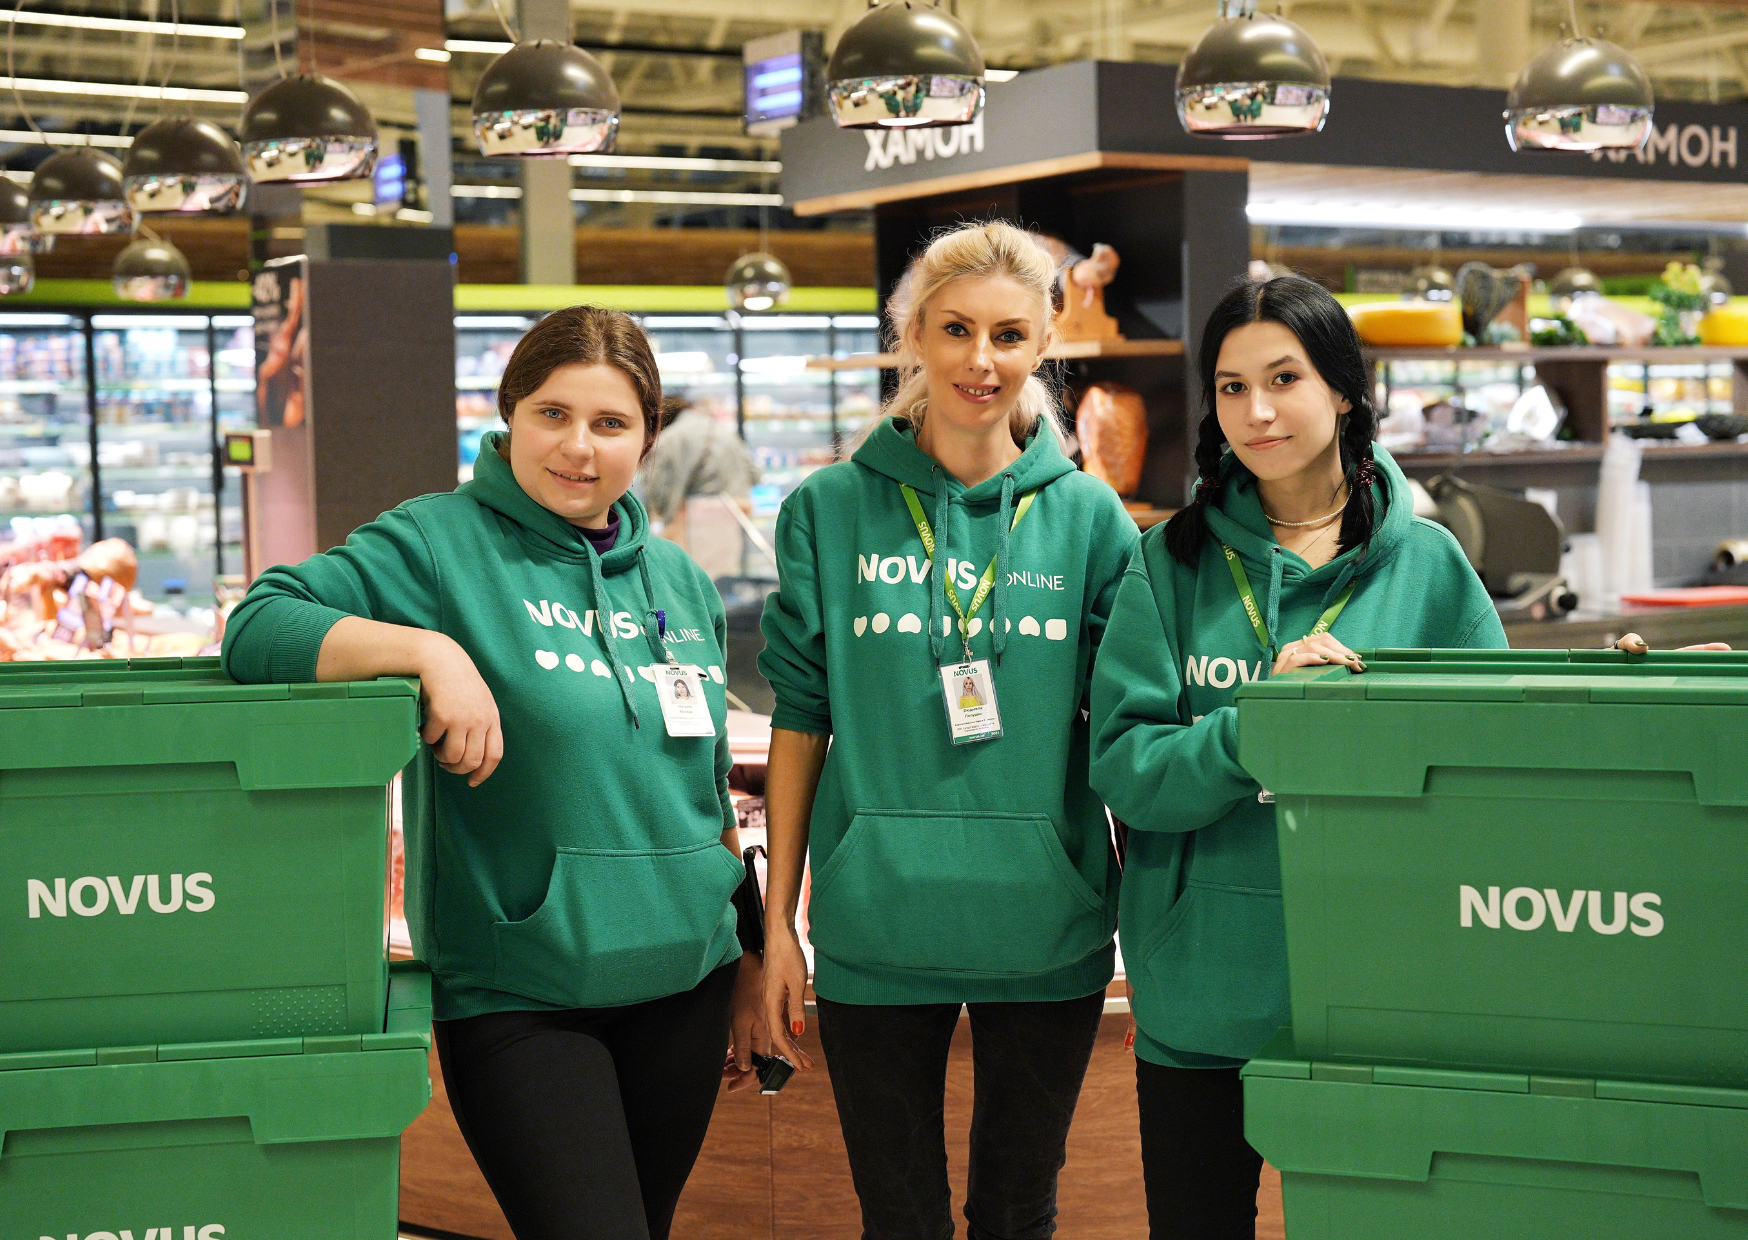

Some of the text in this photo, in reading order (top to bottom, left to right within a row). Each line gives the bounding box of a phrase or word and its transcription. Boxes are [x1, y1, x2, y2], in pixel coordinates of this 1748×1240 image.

[1591, 124, 1737, 169] МОН
[918, 521, 935, 553] NOVUS
[971, 579, 991, 612] NOVUS
[1242, 594, 1261, 628] NOVUS
[662, 627, 706, 644] NLINE
[953, 667, 978, 677] NOVUS
[1185, 654, 1263, 690] NOV
[27, 871, 216, 919] NOVUS
[1459, 884, 1665, 937] NOVUS
